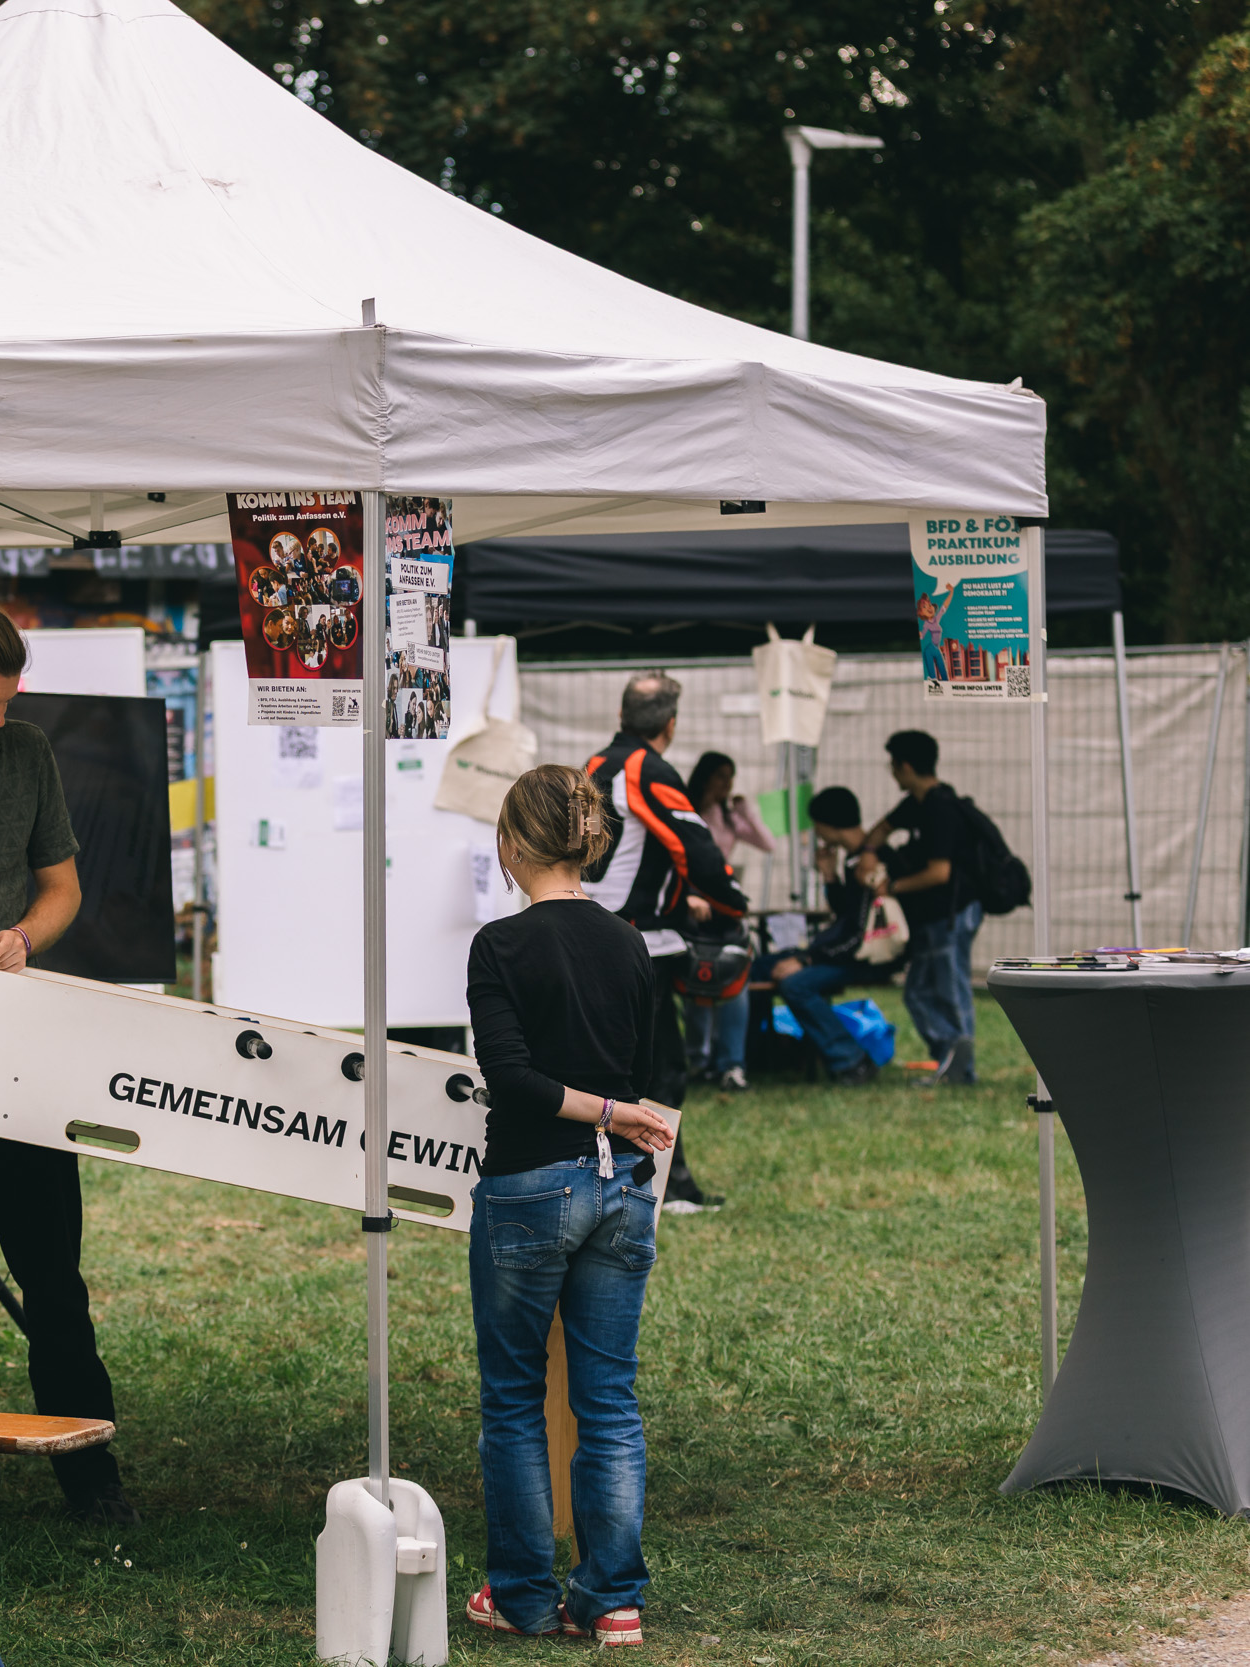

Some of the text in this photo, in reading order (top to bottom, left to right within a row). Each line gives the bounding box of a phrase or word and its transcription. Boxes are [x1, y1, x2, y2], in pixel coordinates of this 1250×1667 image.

[236, 490, 356, 509] KOMM INS TEAM
[385, 512, 426, 534] KOMM
[926, 520, 960, 534] BFD
[966, 519, 979, 532] &
[386, 530, 450, 553] INS TEAM
[928, 536, 1020, 550] PRAKTIKUM
[928, 554, 1020, 566] AUSBILDUNG
[400, 564, 432, 576] POLITIK ZUM
[399, 575, 436, 588] ANFASSEN E.V.
[108, 1072, 486, 1176] GEMEINSAM EWIN
